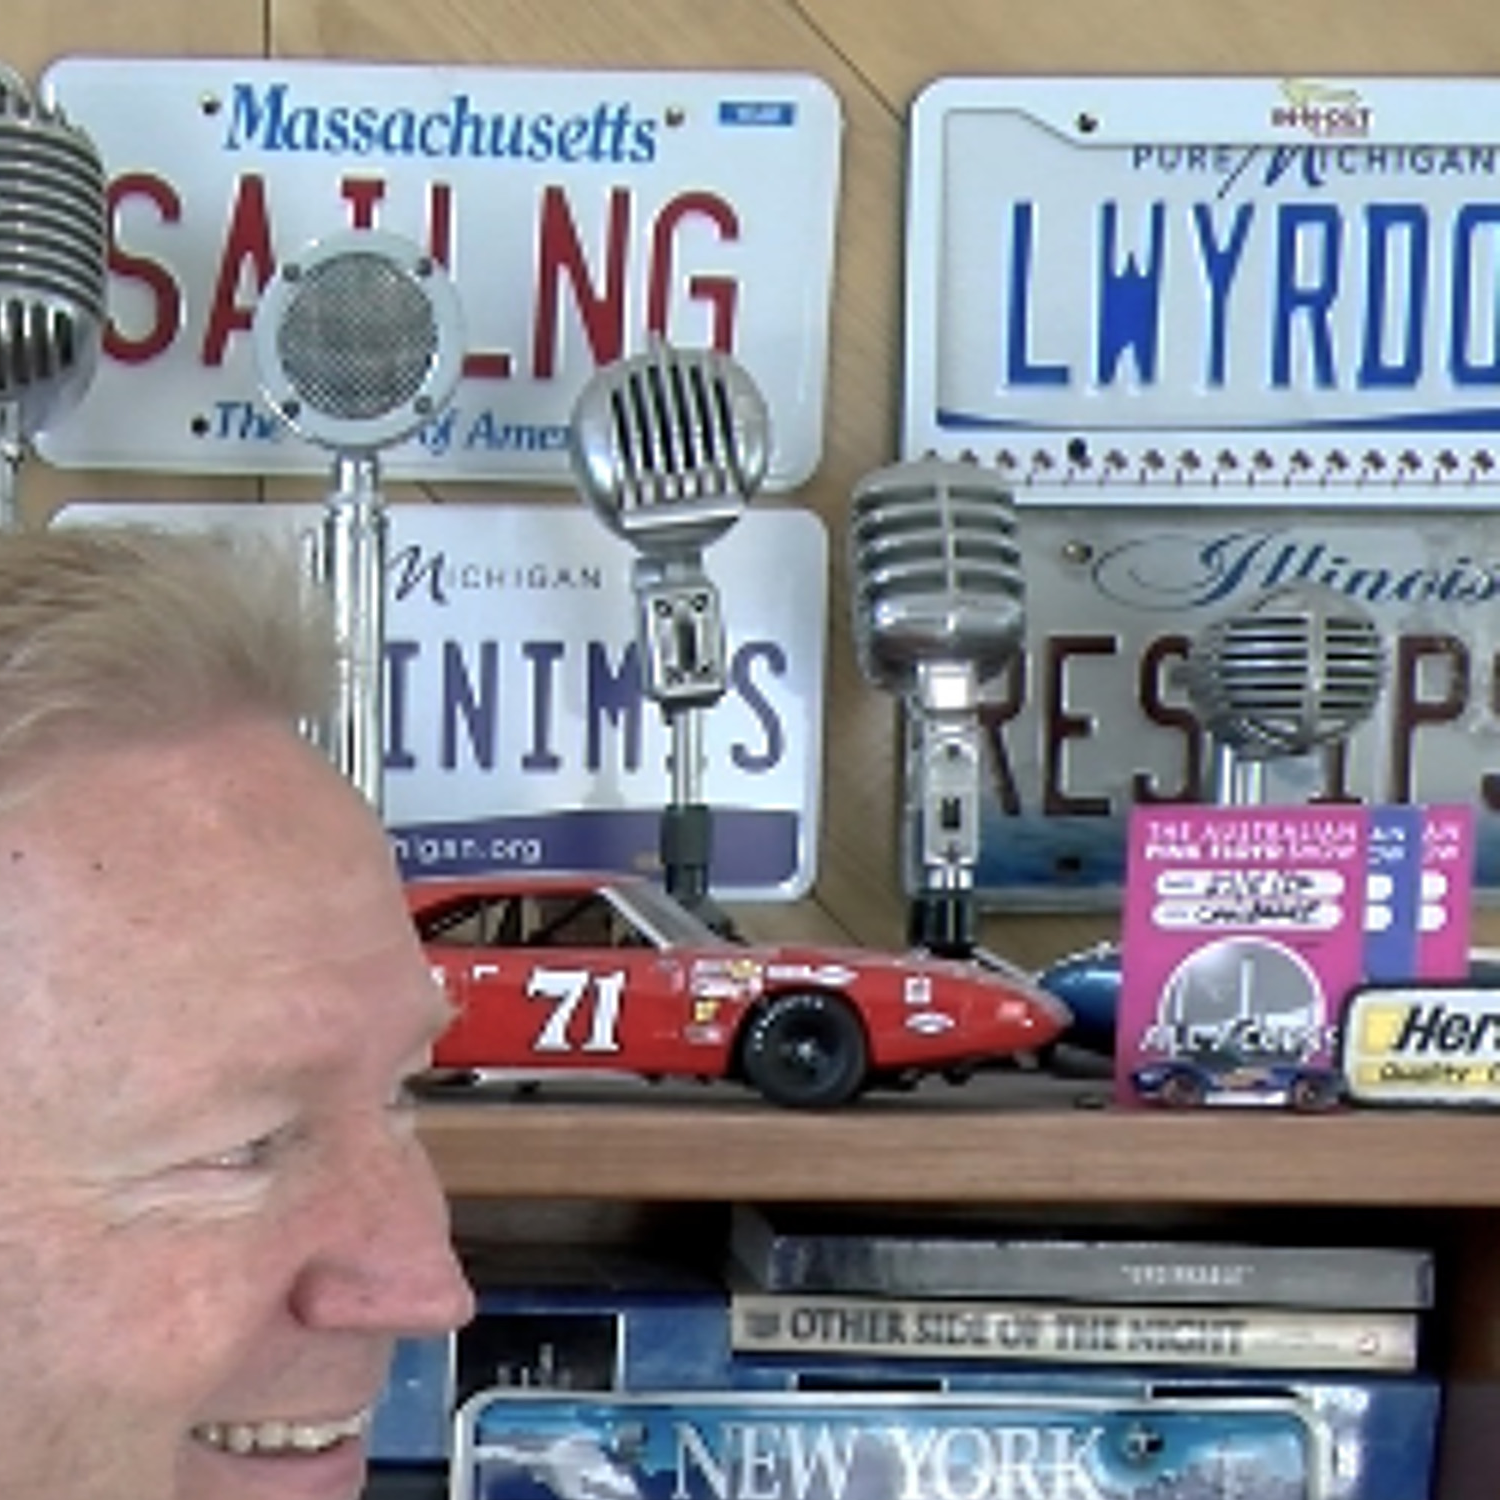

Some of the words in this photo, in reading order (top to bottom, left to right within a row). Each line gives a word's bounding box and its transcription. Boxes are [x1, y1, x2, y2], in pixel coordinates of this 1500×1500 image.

[224, 82, 658, 163] Massachusetts
[1133, 143, 1234, 172] PURE
[1262, 144, 1495, 187] MICHIGAN
[389, 544, 602, 606] MICHIGAN
[1192, 527, 1500, 607] Illinois
[527, 968, 626, 1052] 71
[790, 1307, 907, 1346] OTHER
